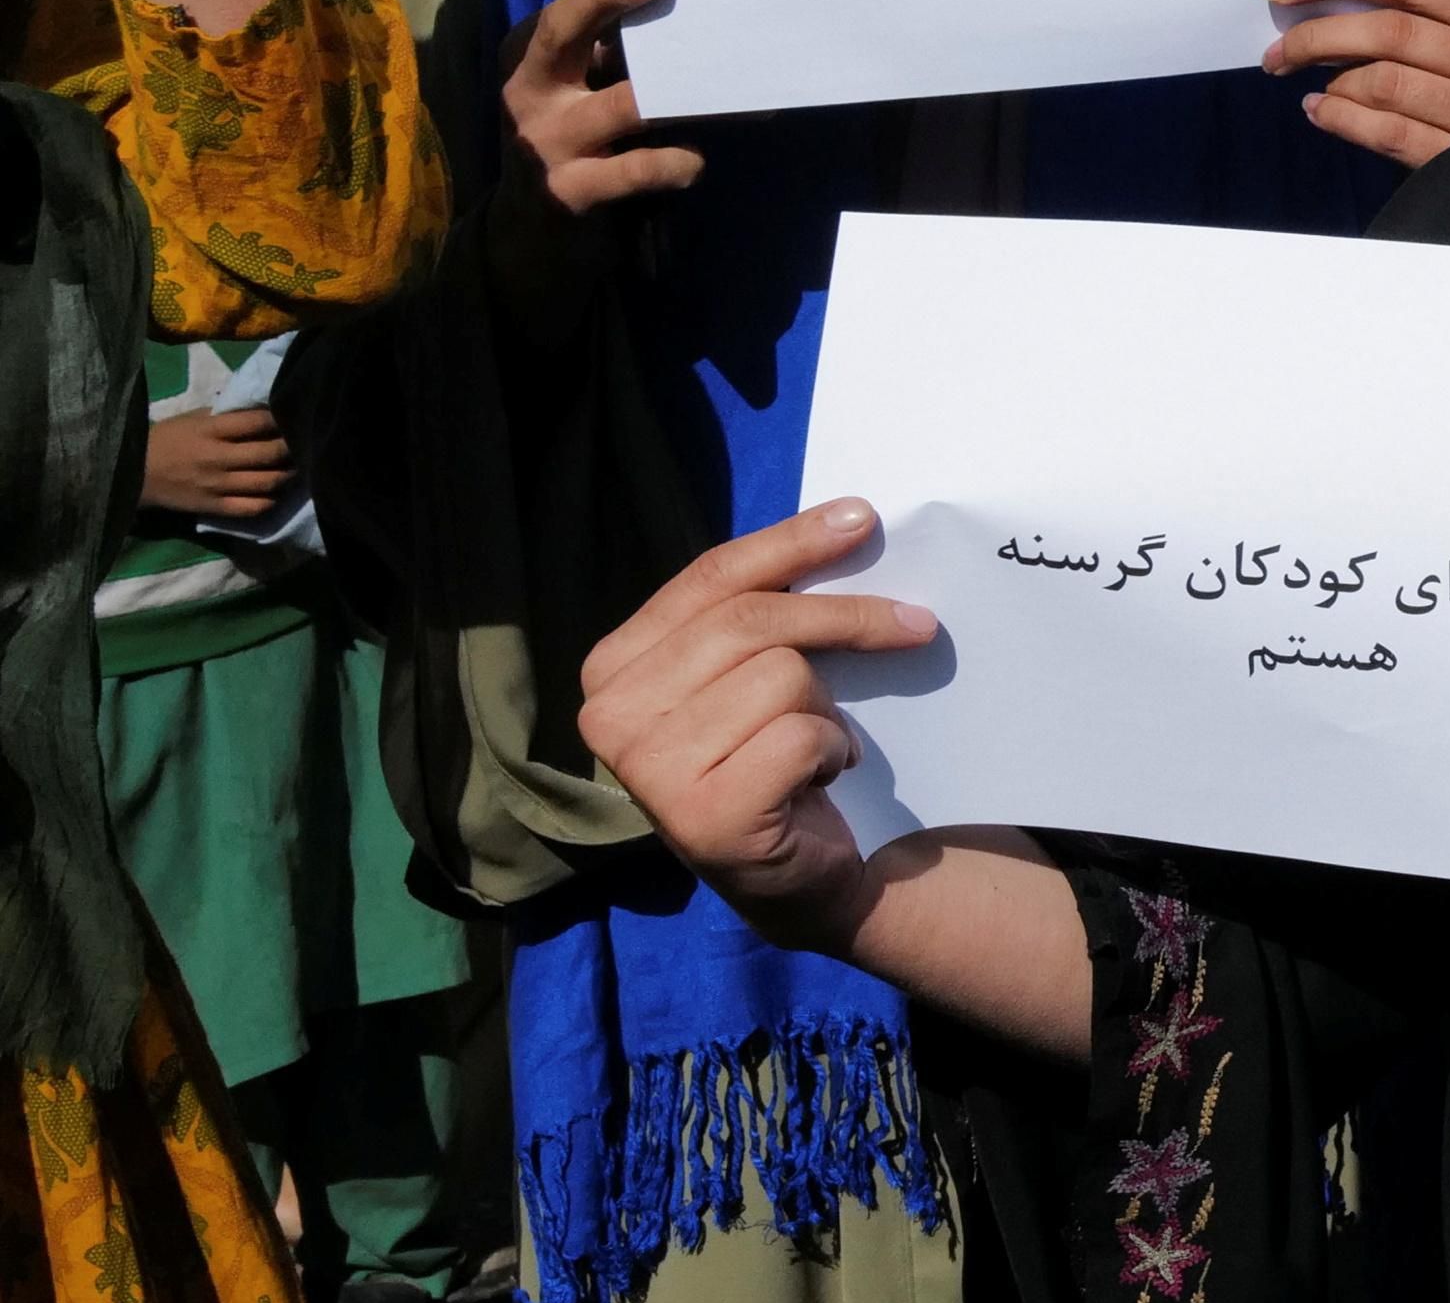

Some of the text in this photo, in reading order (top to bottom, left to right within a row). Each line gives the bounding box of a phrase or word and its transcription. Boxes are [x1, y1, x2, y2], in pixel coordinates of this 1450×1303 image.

[997, 533, 1167, 592] گرسنه
[1185, 541, 1378, 609] کودکان
[1248, 635, 1398, 677] هستم
